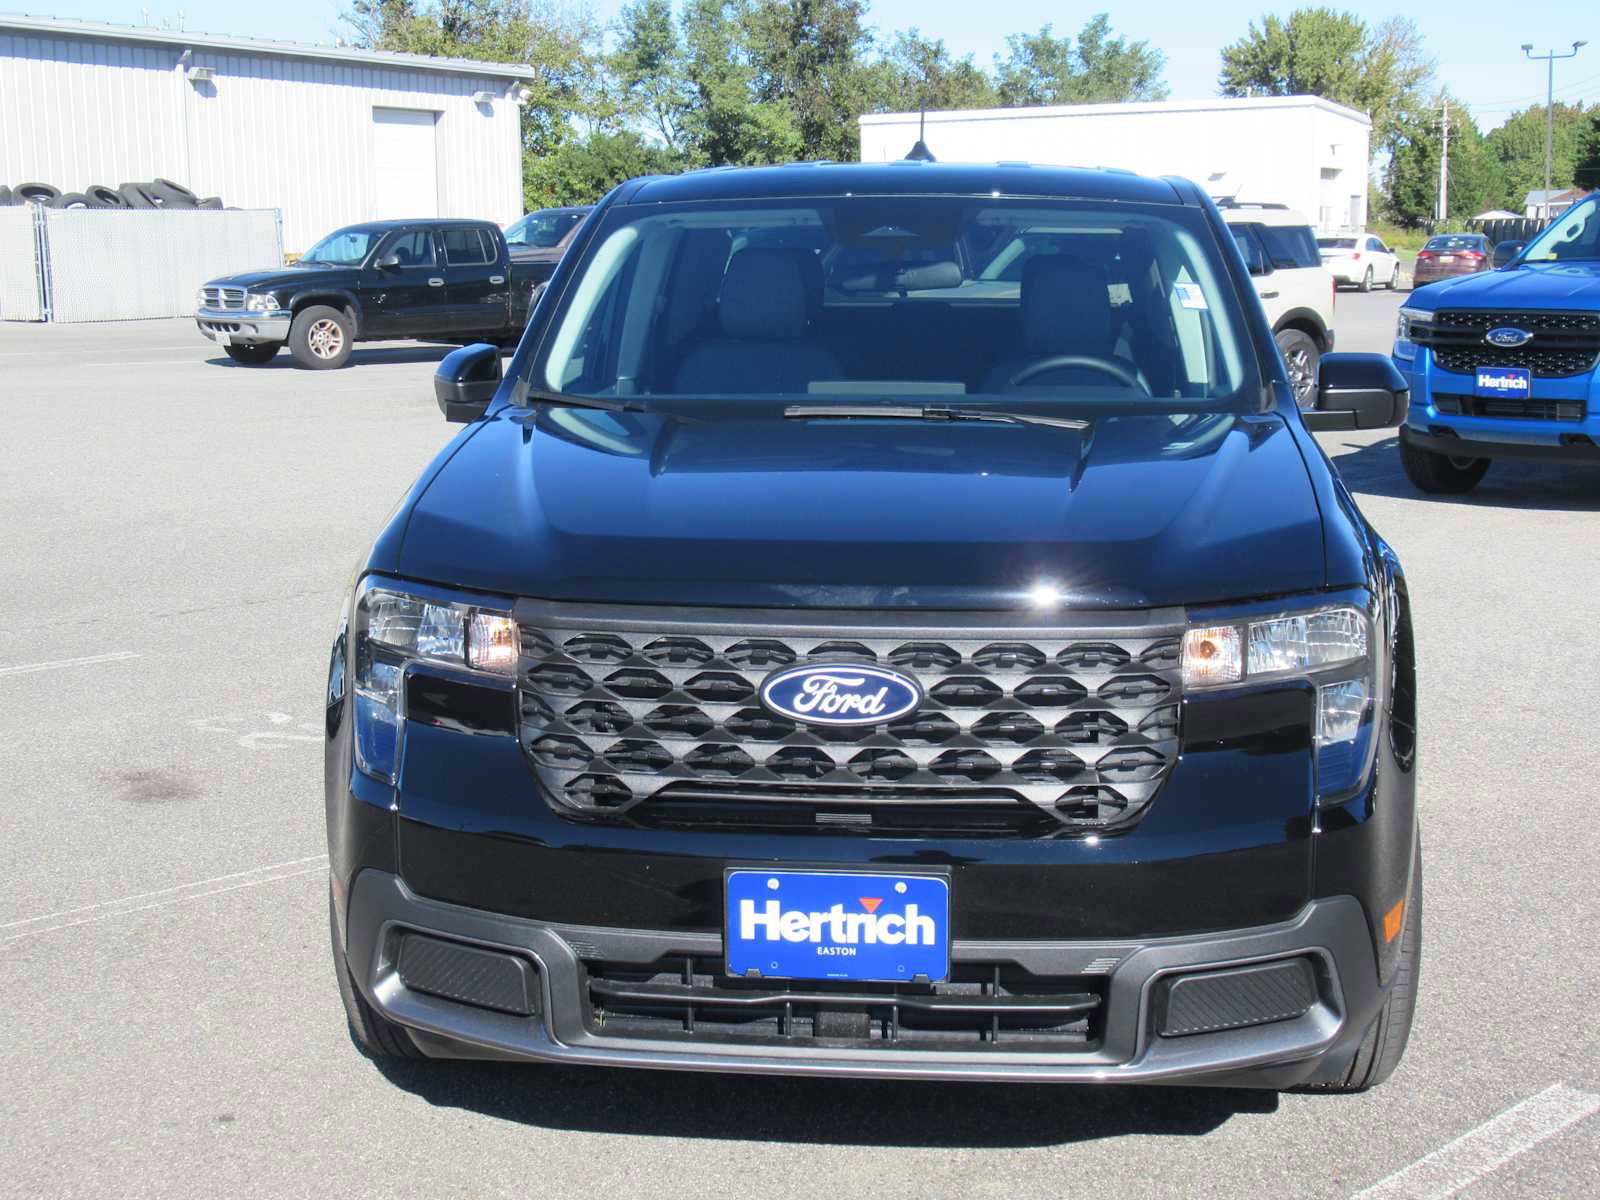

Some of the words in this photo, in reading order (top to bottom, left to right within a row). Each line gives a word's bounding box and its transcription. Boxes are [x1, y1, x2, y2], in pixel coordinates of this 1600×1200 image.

[1478, 374, 1528, 389] Hertrich
[793, 674, 889, 714] Ford
[740, 898, 936, 945] Hertrich
[817, 947, 857, 956] EASTON
